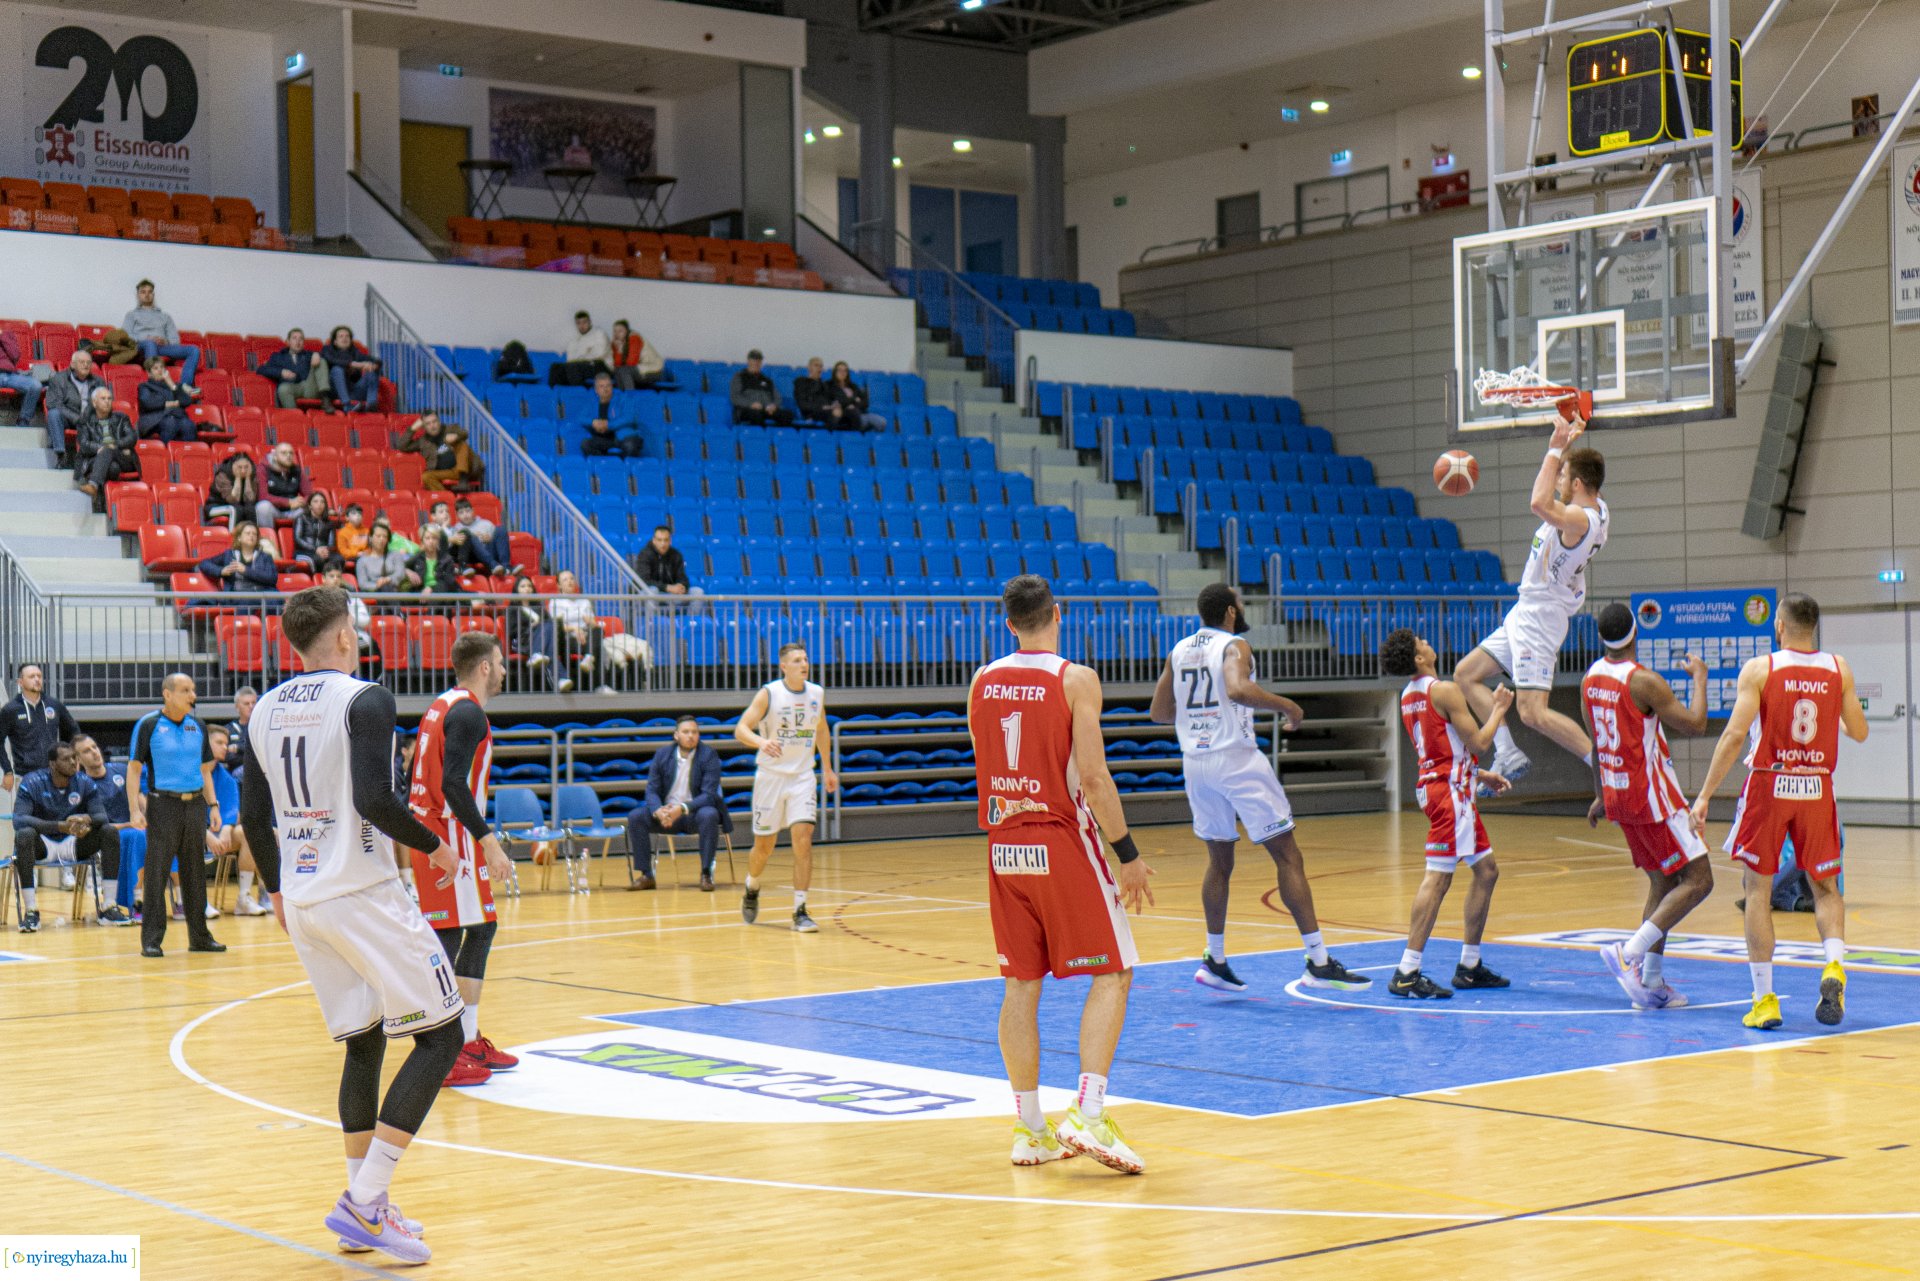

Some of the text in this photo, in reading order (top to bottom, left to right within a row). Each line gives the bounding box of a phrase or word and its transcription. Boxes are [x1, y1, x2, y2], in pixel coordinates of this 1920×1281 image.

[35, 25, 199, 143] 20
[94, 130, 190, 161] Eissmann
[94, 157, 190, 175] Group Automotive
[35, 210, 79, 223] Eissmann
[157, 220, 199, 233] Eissmann
[1901, 268, 1920, 280] MAGY
[1734, 308, 1759, 321] EZÉS
[1706, 602, 1737, 612] FUTSAL
[1675, 613, 1731, 624] NYÍREGYHÁZA
[278, 681, 325, 703] BAZSÓ
[983, 685, 1046, 701] DEMETER
[1181, 667, 1220, 709] 22
[1587, 687, 1620, 703] CRAWLEY
[1785, 680, 1829, 694] MIJOVIC
[795, 713, 805, 727] 12
[1592, 705, 1620, 751] 53
[1791, 699, 1818, 744] 8
[1000, 711, 1022, 770] 1
[1776, 749, 1824, 763] HONVÉD
[280, 736, 312, 808] 11
[284, 810, 329, 819] BLADESPORT
[287, 828, 328, 841] ALANEX
[435, 964, 453, 997] 11
